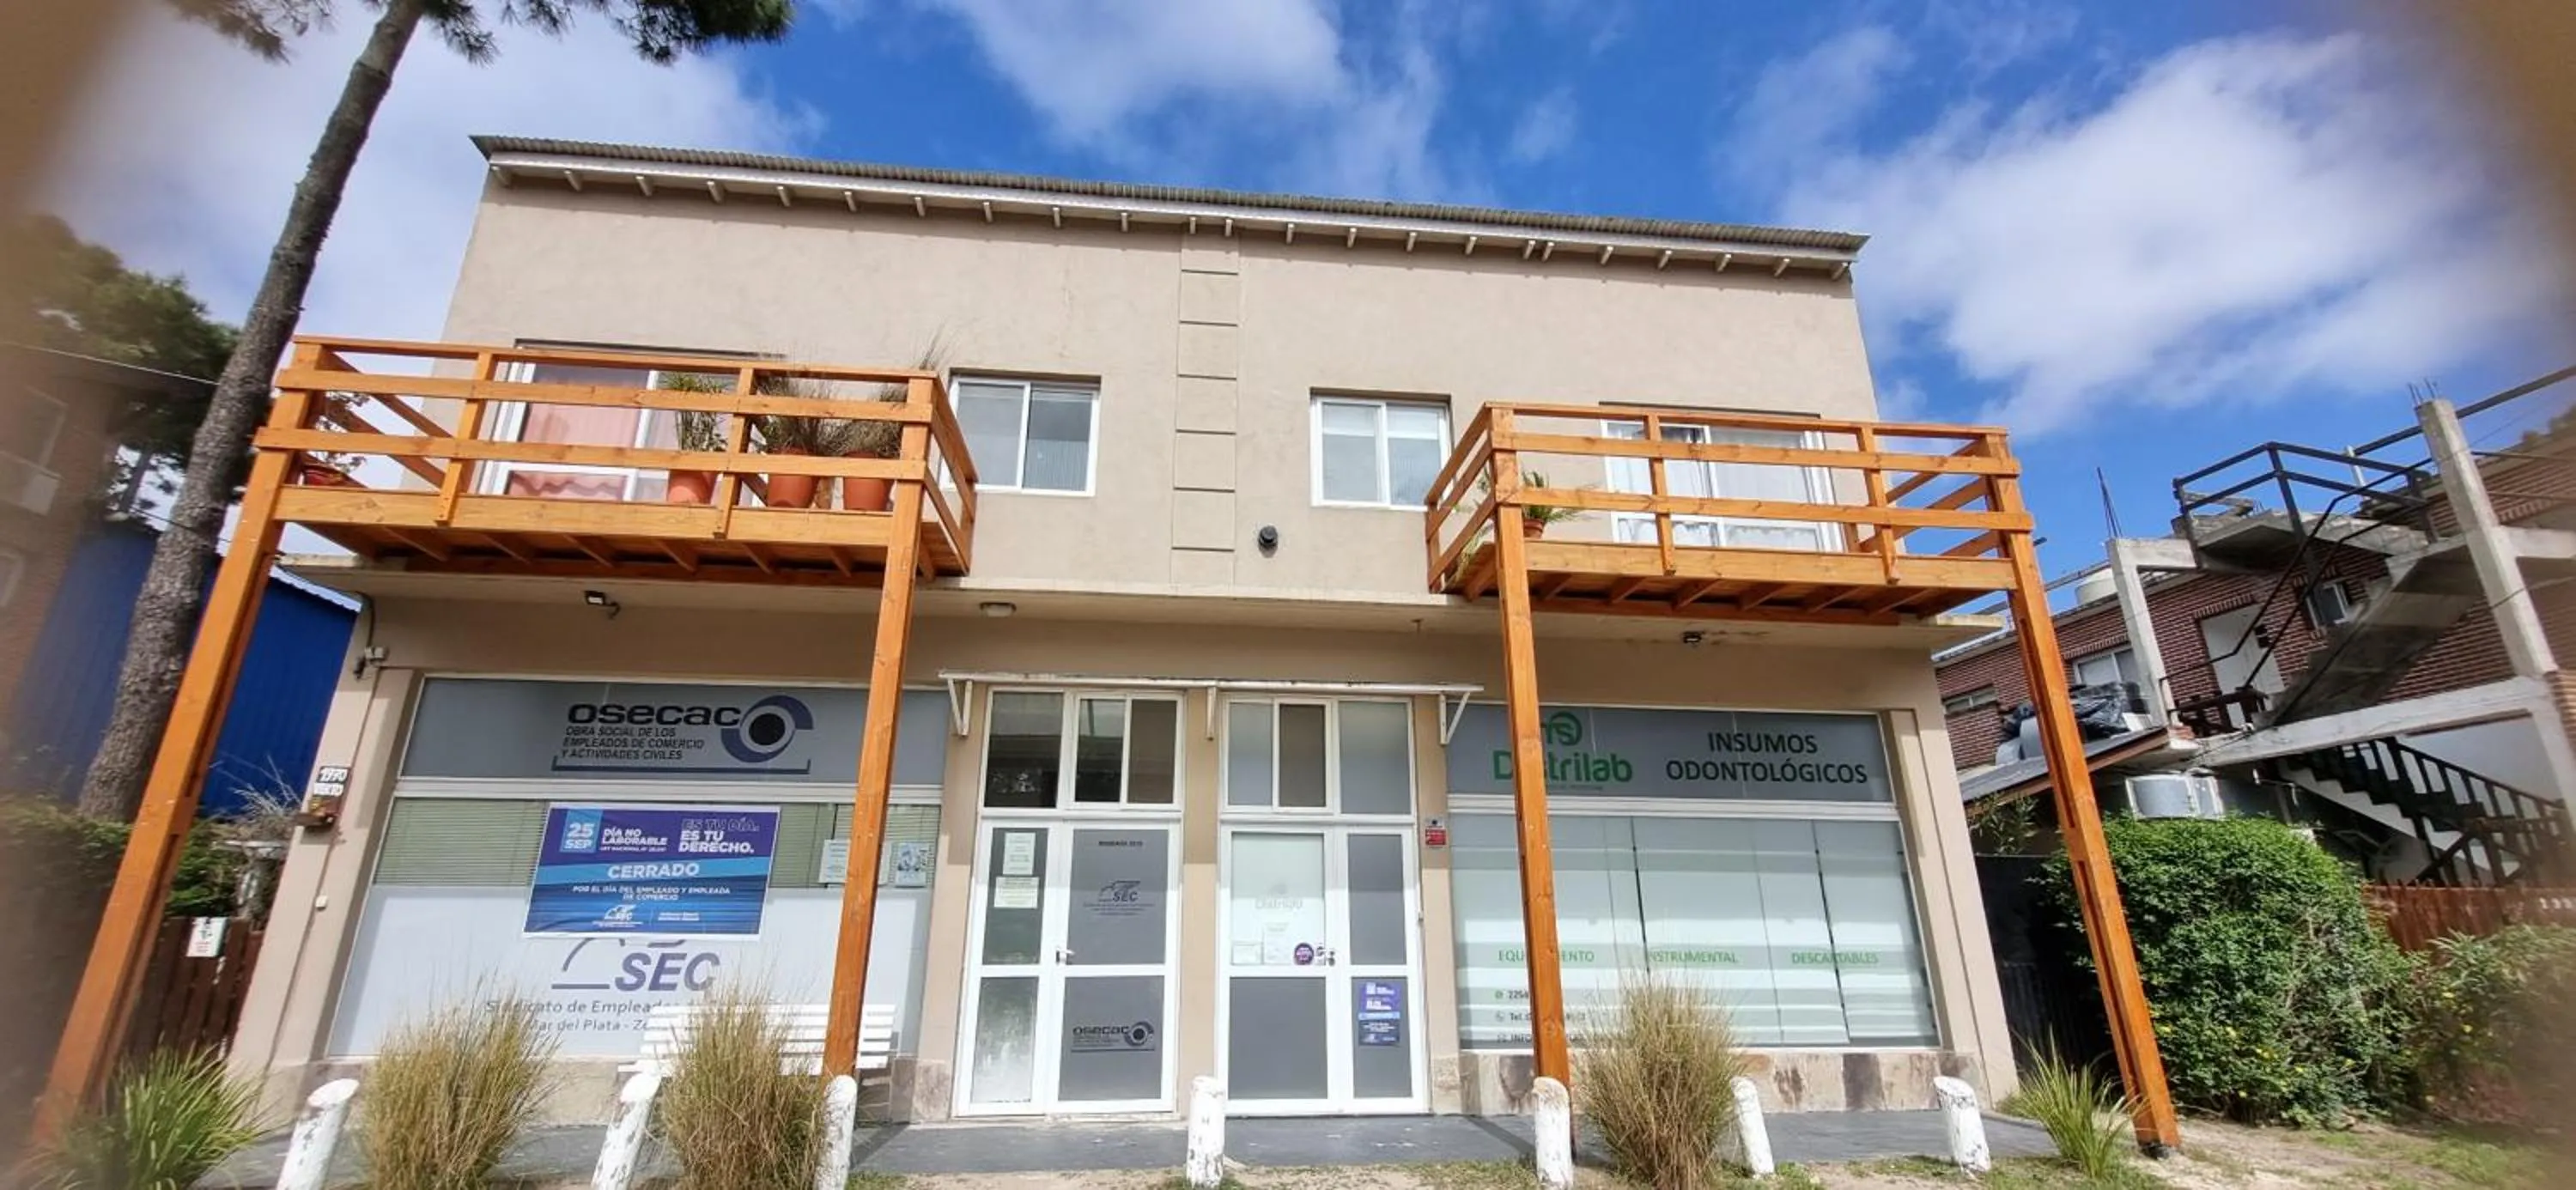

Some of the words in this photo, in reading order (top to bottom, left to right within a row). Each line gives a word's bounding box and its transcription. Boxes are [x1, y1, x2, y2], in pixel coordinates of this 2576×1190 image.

[566, 726, 595, 736] OBRA
[598, 726, 634, 737] SOCIAL
[638, 727, 652, 737] DE
[656, 727, 676, 737] LOS
[563, 738, 628, 748] EMPLEADOS
[631, 738, 645, 748] DE
[648, 738, 704, 749] COMERCIO
[1707, 732, 1818, 754] INSUMOS
[561, 750, 568, 758] Y
[570, 750, 639, 760] ACTIVIDADES
[642, 750, 683, 760] CIVILES
[1492, 750, 1632, 782] Dtrilab
[1666, 758, 1868, 784] ODONTOLÓGICOS
[567, 823, 595, 838] 25
[603, 826, 623, 836] DÍA
[625, 828, 641, 837] NO
[680, 830, 700, 841] ES
[703, 830, 724, 841] TU
[564, 839, 592, 849] SEP
[602, 836, 668, 846] LABORABLE
[678, 841, 755, 853] DERECHO.
[607, 862, 700, 879] CERRADO
[602, 884, 617, 894] DÍA
[688, 886, 730, 895] EMPLEADA
[615, 952, 720, 993] SEC
[568, 999, 586, 1012] de
[557, 1018, 580, 1031] del
[583, 1019, 620, 1031] Plata
